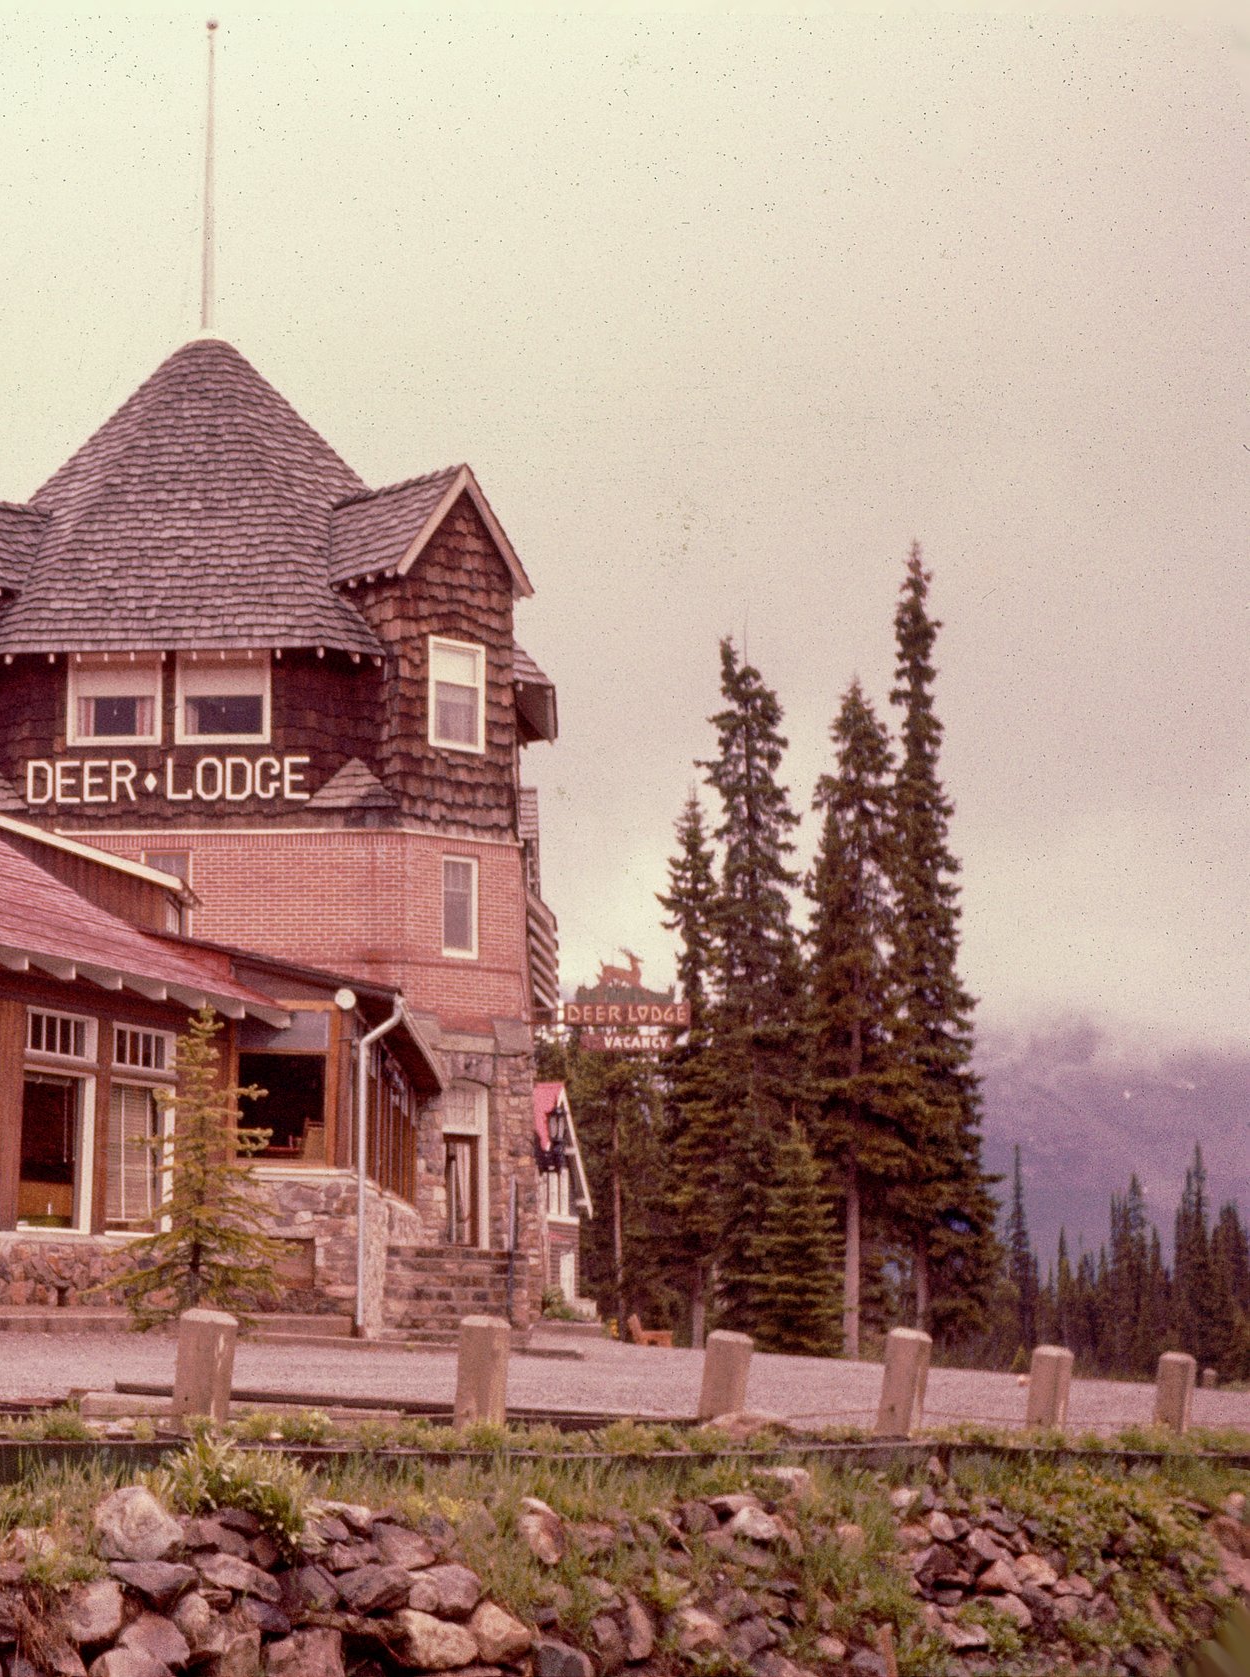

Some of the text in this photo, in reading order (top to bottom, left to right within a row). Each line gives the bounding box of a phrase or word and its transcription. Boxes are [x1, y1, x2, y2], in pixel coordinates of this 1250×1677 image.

[27, 757, 310, 803] DEER LODGE
[567, 1005, 687, 1021] DEER LODGE
[604, 1036, 668, 1048] VACANCY
